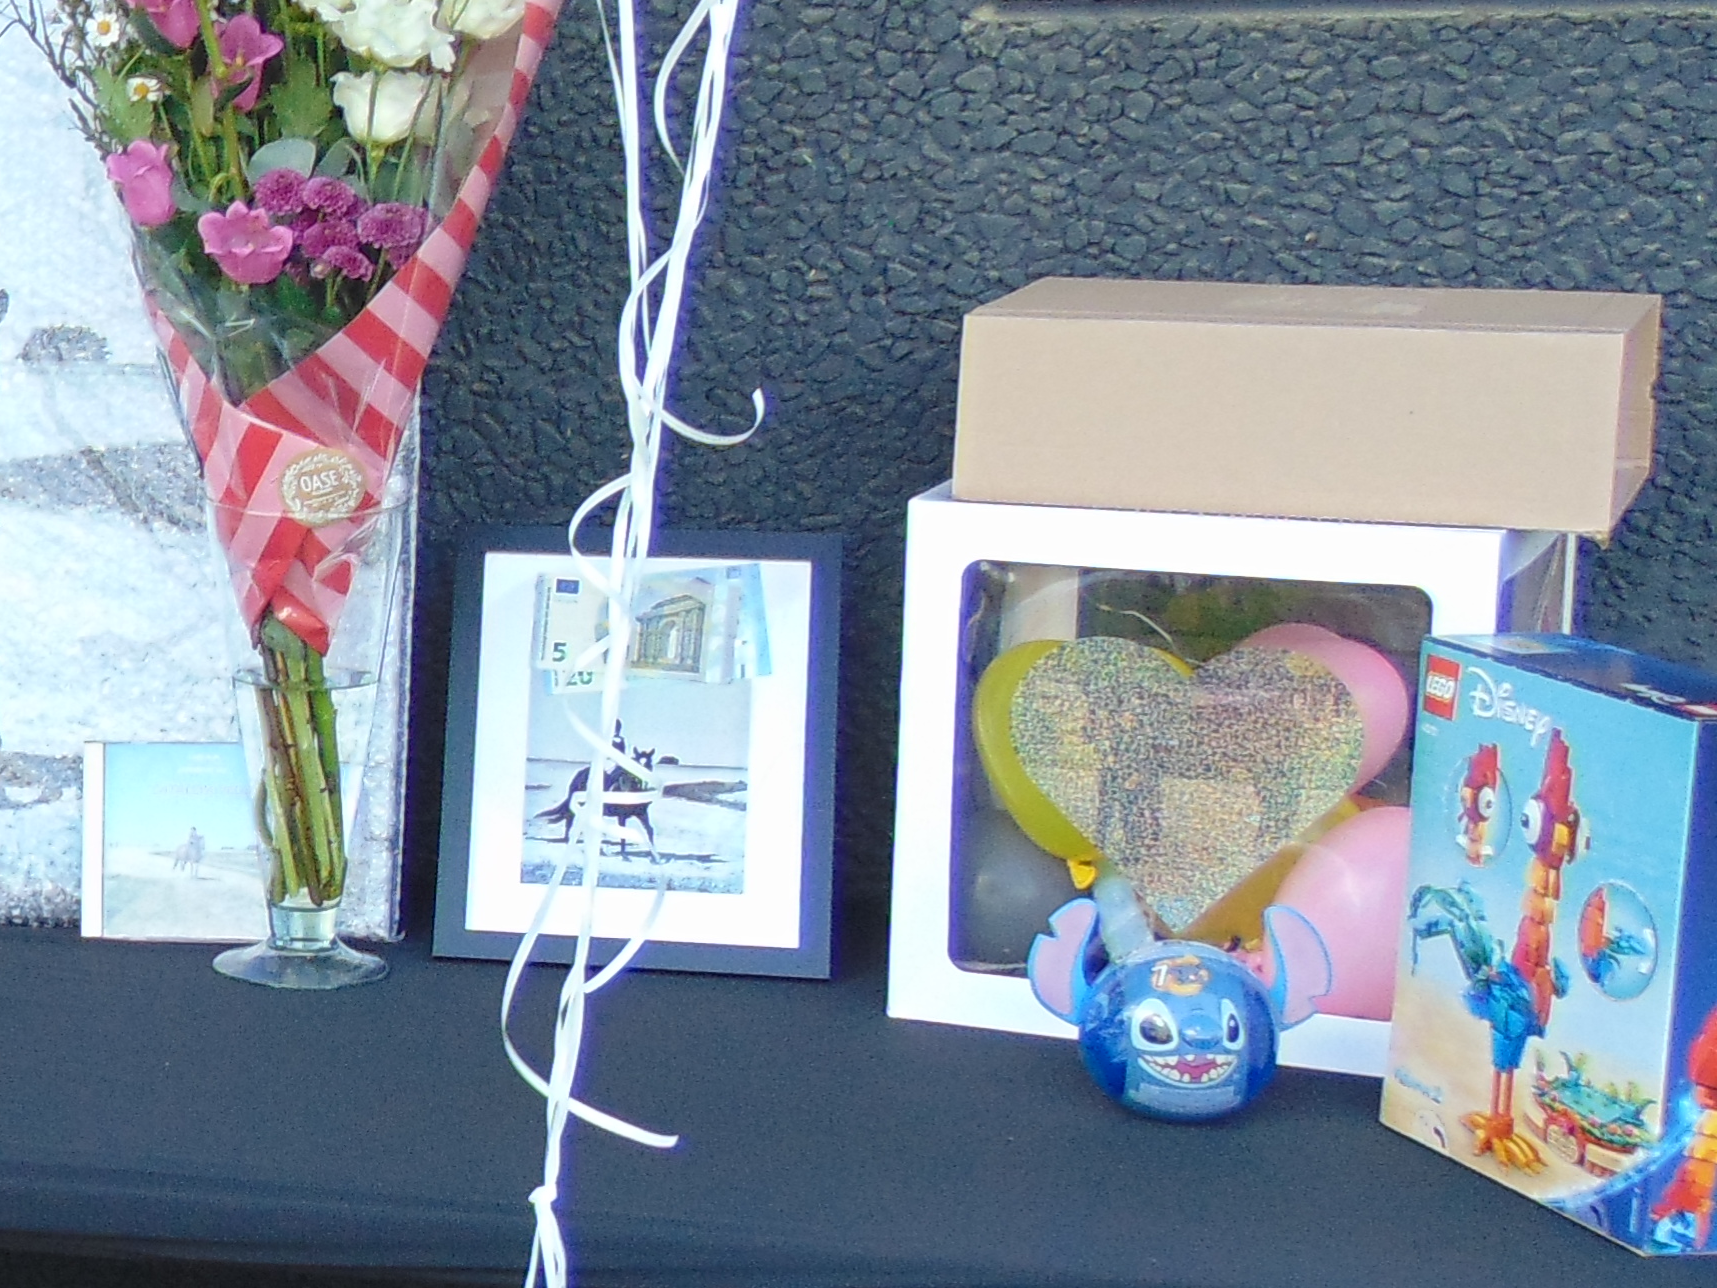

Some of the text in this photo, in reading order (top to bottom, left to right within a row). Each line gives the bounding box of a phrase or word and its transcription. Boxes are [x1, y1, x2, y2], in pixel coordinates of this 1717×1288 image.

[300, 470, 339, 491] OASE
[552, 642, 567, 662] 5
[1426, 674, 1455, 700] LEGO
